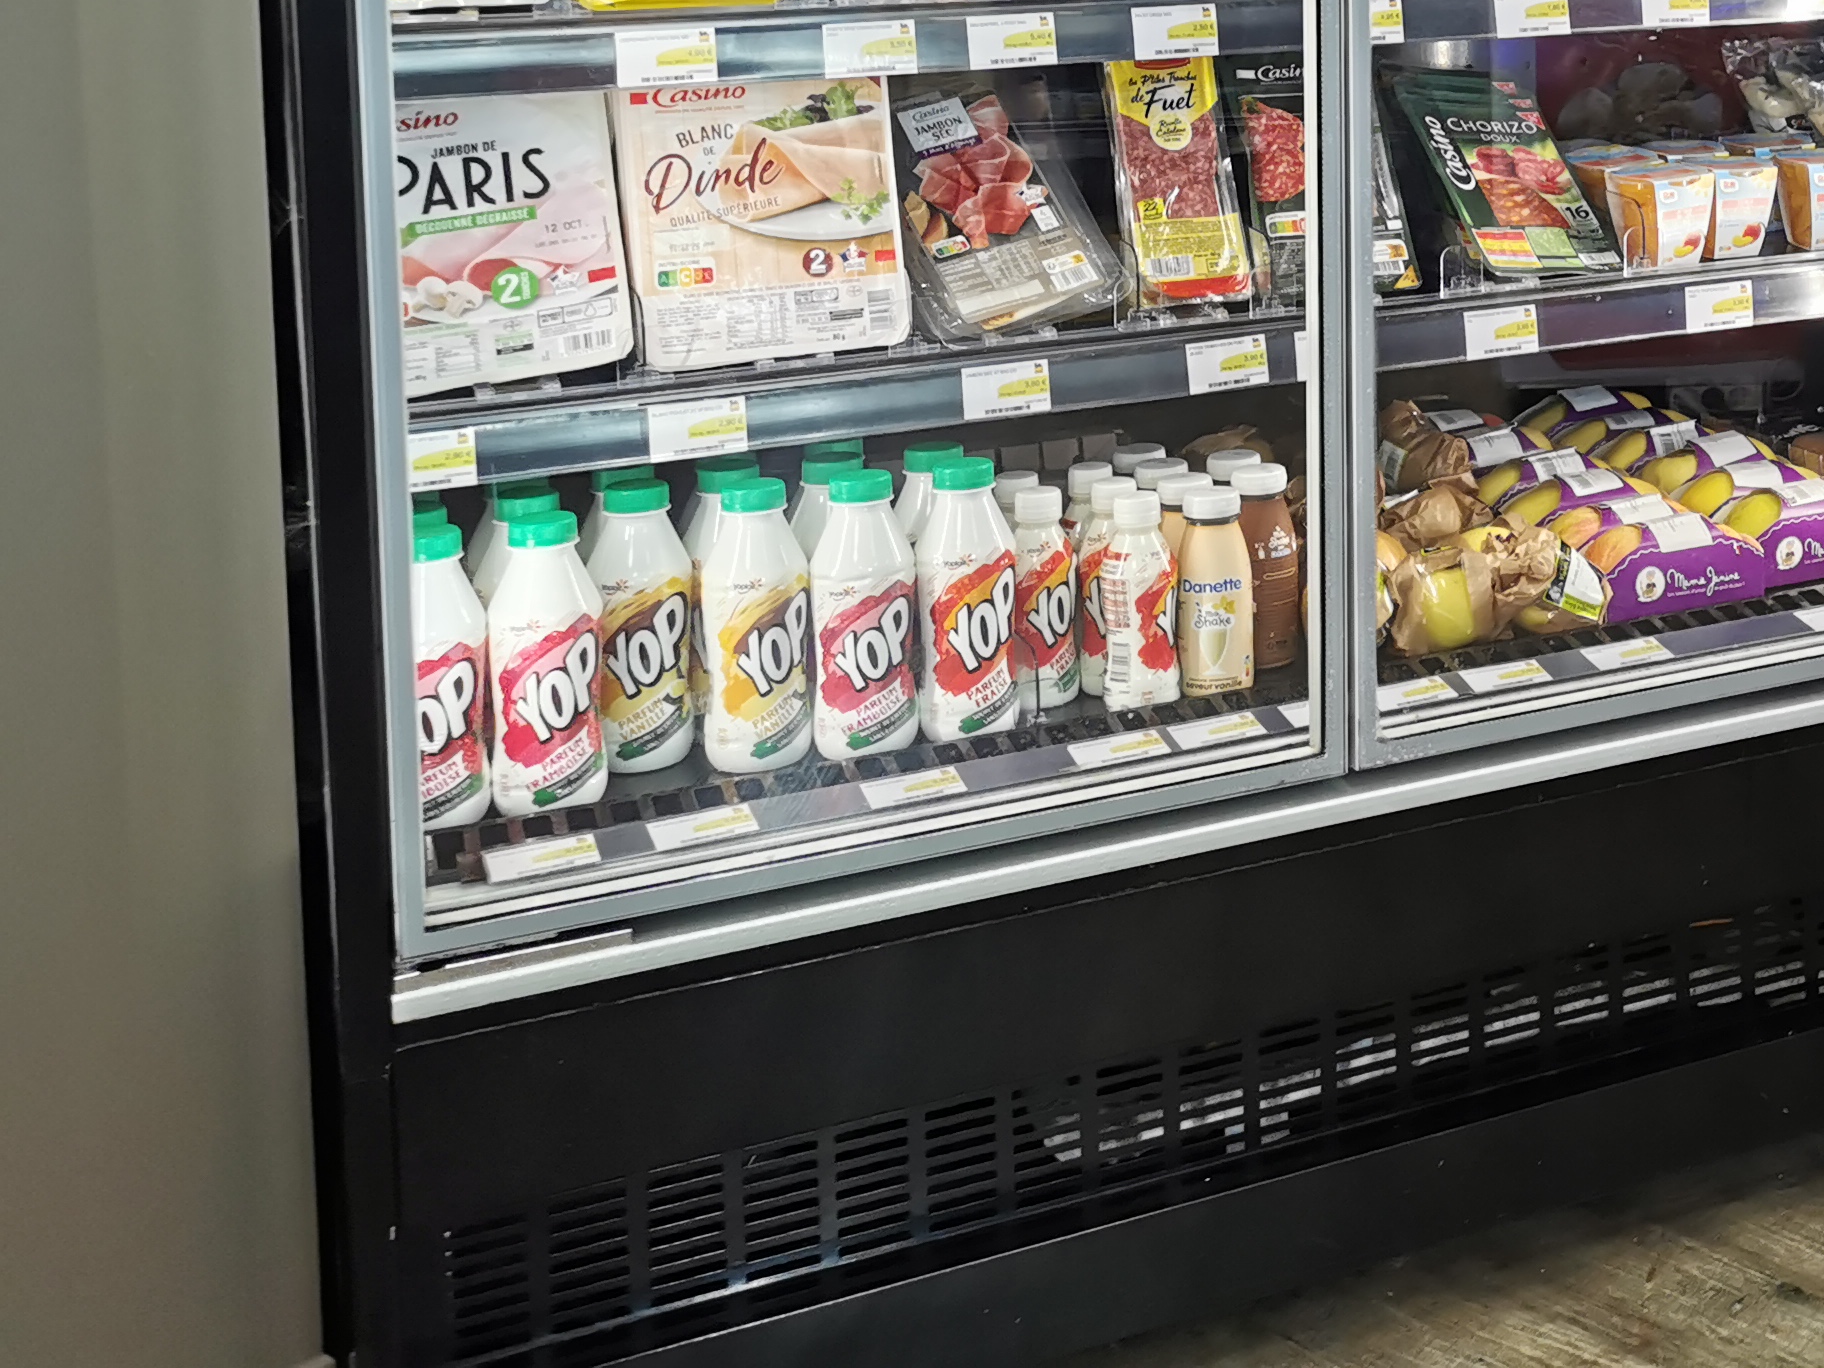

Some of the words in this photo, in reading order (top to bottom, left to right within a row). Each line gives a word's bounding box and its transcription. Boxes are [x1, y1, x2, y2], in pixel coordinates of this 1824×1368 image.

[1130, 91, 1145, 105] de
[1144, 83, 1197, 119] Fuet
[675, 123, 735, 150] BLANC
[914, 115, 963, 137] JAMBON
[932, 128, 955, 143] SEC
[1446, 117, 1538, 135] CHORIZO
[1480, 132, 1521, 144] DOUX
[431, 142, 480, 160] JAMBON
[481, 139, 497, 152] DE
[703, 146, 716, 157] DE
[1424, 115, 1477, 192] Casino
[644, 137, 785, 216] Dinde
[669, 209, 714, 228] QUALITÉ
[715, 195, 781, 219] SUPÉRIEURE
[1564, 204, 1590, 222] 16
[497, 273, 521, 304] 2
[1182, 577, 1243, 595] Danette
[1666, 567, 1706, 591] Mamie
[1706, 565, 1741, 592] Janine
[946, 565, 1015, 674] YOP
[1193, 613, 1232, 629] Shake
[605, 591, 687, 700] YOP
[736, 585, 808, 698] YOP
[833, 594, 911, 692] YOP
[514, 628, 600, 745] YOP
[964, 666, 1006, 701] PARFUM
[973, 676, 1009, 710] FRAISE
[617, 696, 665, 729] PARFUM
[750, 694, 793, 728] PARFUM
[840, 693, 903, 735] FRAMBOISE
[854, 684, 899, 718] PARFUM
[619, 706, 668, 742] VANILLE
[753, 705, 798, 740] VANILLE
[525, 746, 590, 792] FRAMBOISE
[540, 736, 586, 771] PARFUM
